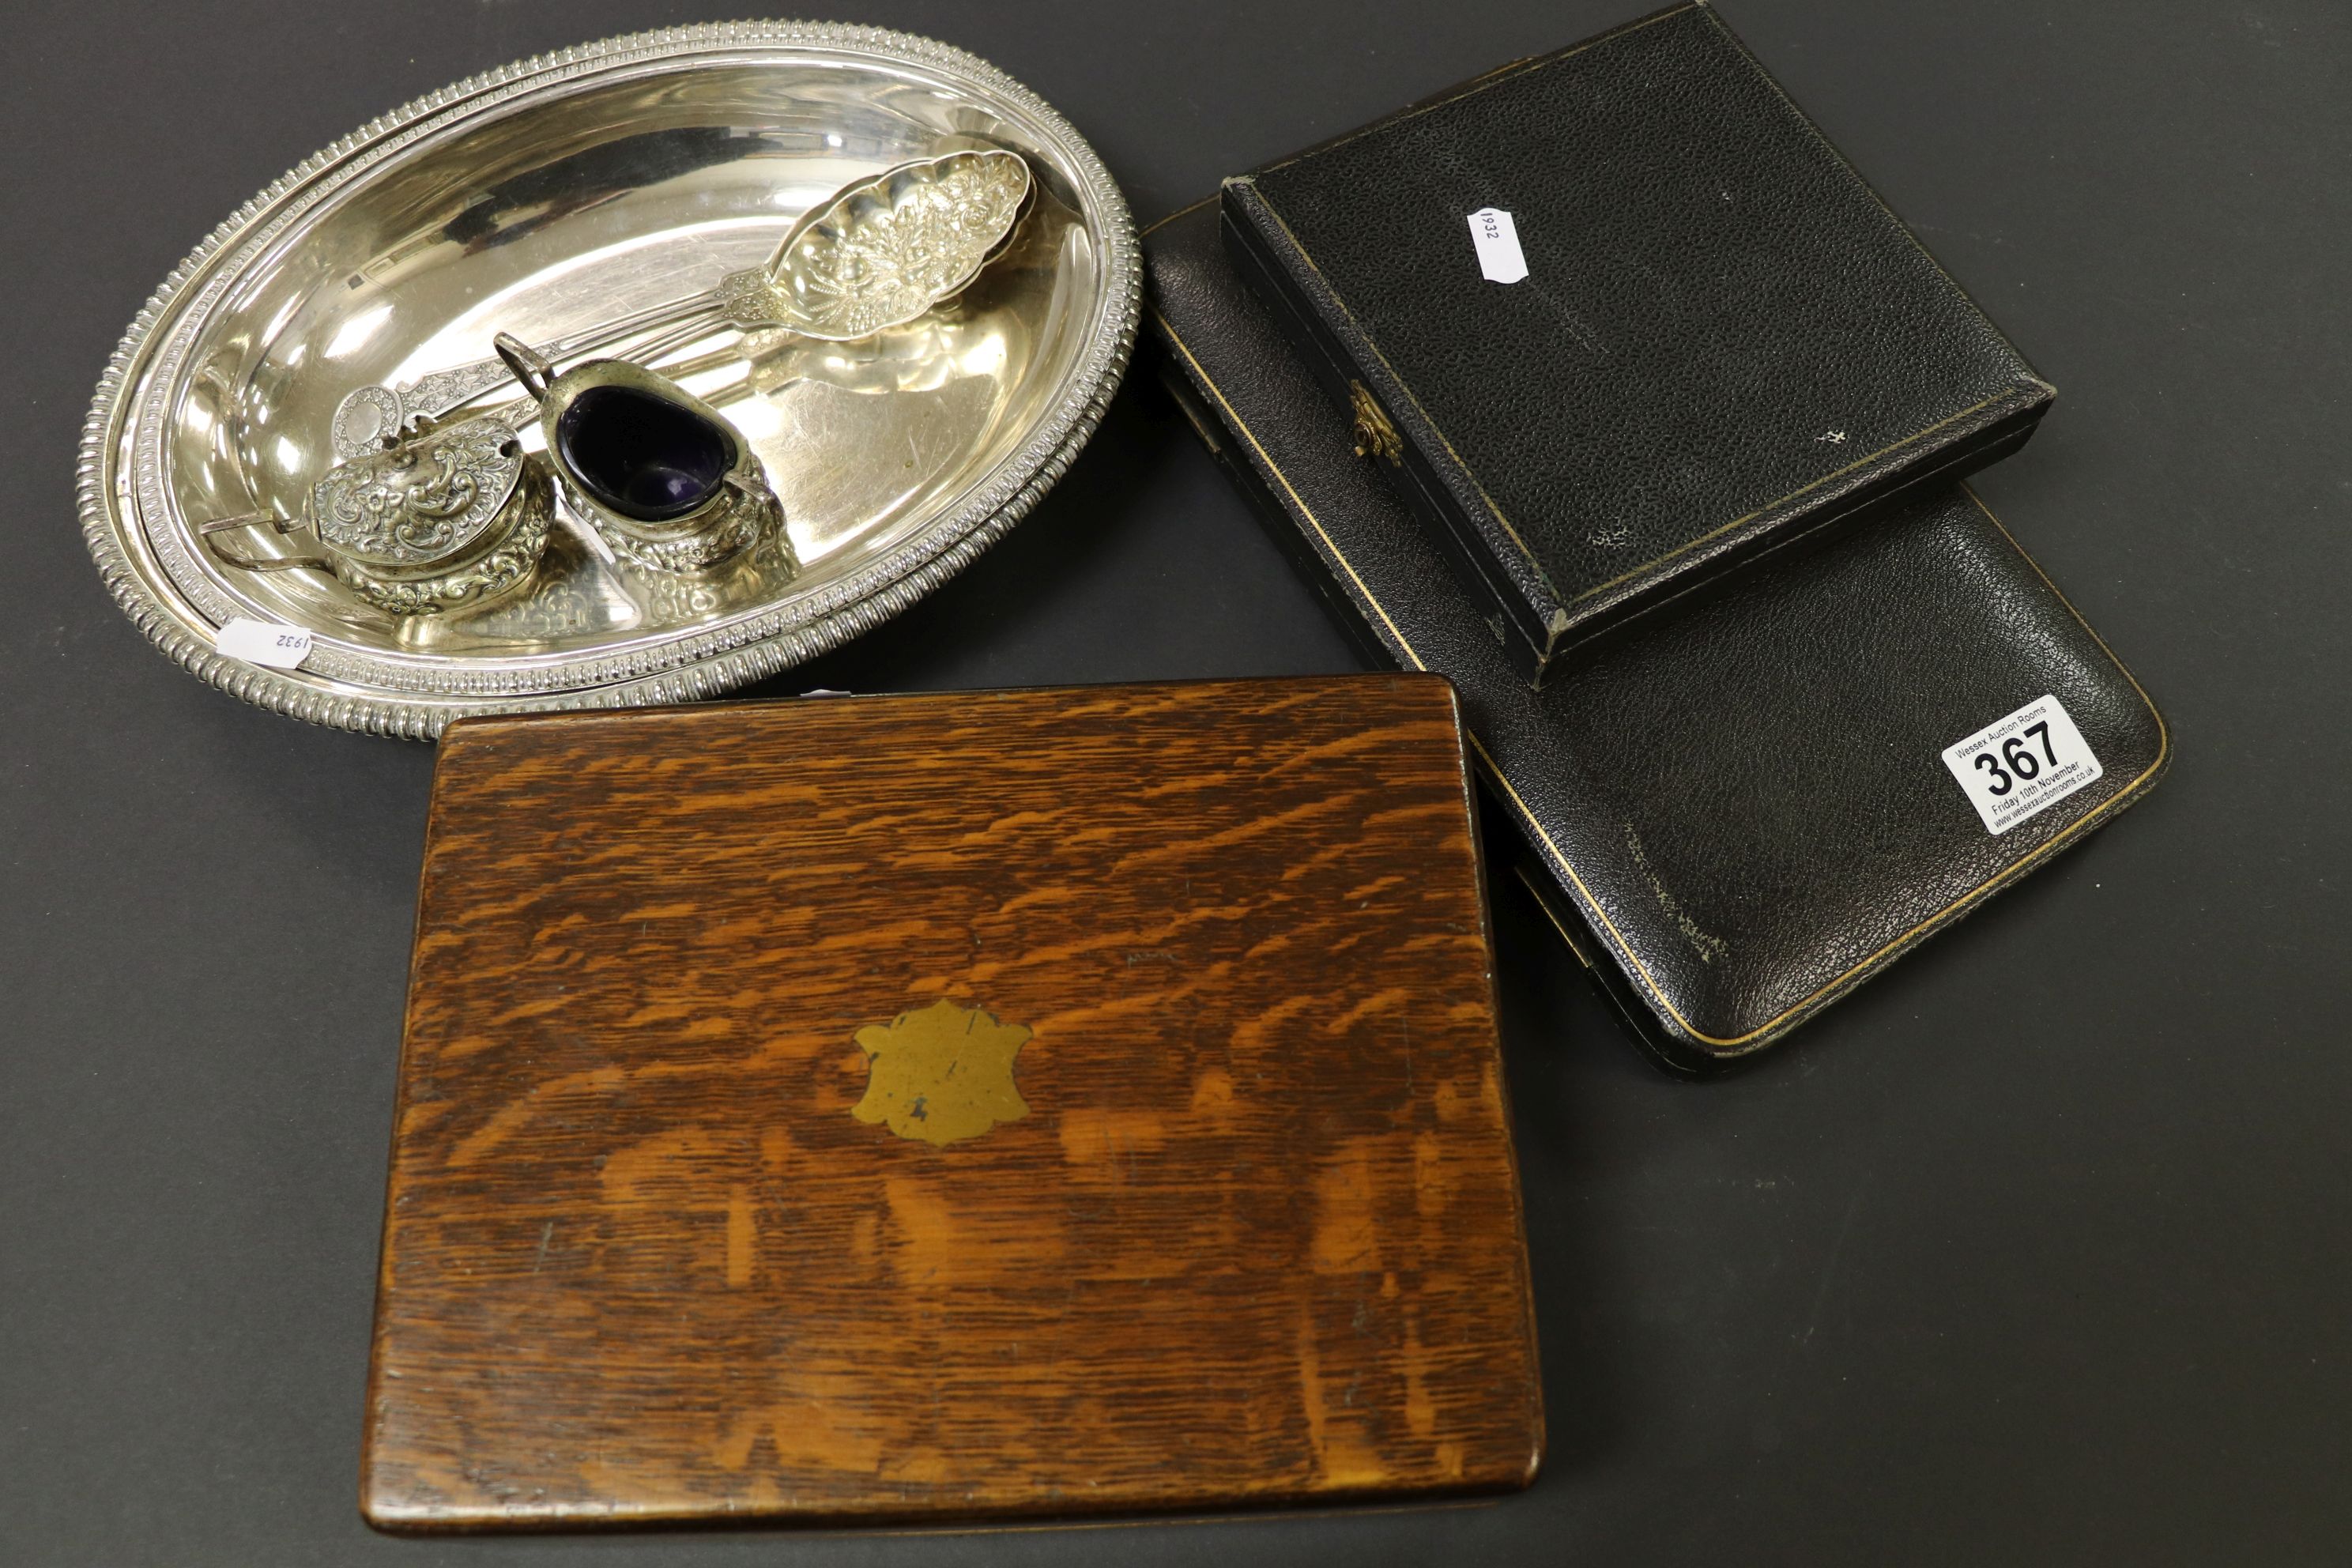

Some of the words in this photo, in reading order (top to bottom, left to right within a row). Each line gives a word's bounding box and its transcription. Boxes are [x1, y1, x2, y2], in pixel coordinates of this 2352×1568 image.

[1480, 213, 1499, 239] 1932
[277, 635, 309, 649] 1932
[1954, 737, 1990, 759] Wessex
[1988, 721, 2018, 742] Auction
[2017, 706, 2047, 726] Rooms
[1974, 720, 2058, 796] 367
[1992, 795, 2019, 816] Friday
[2019, 784, 2038, 801] 10th
[2037, 760, 2080, 789] November
[1994, 765, 2095, 828] www.wessexauctionrooms.co.uk
